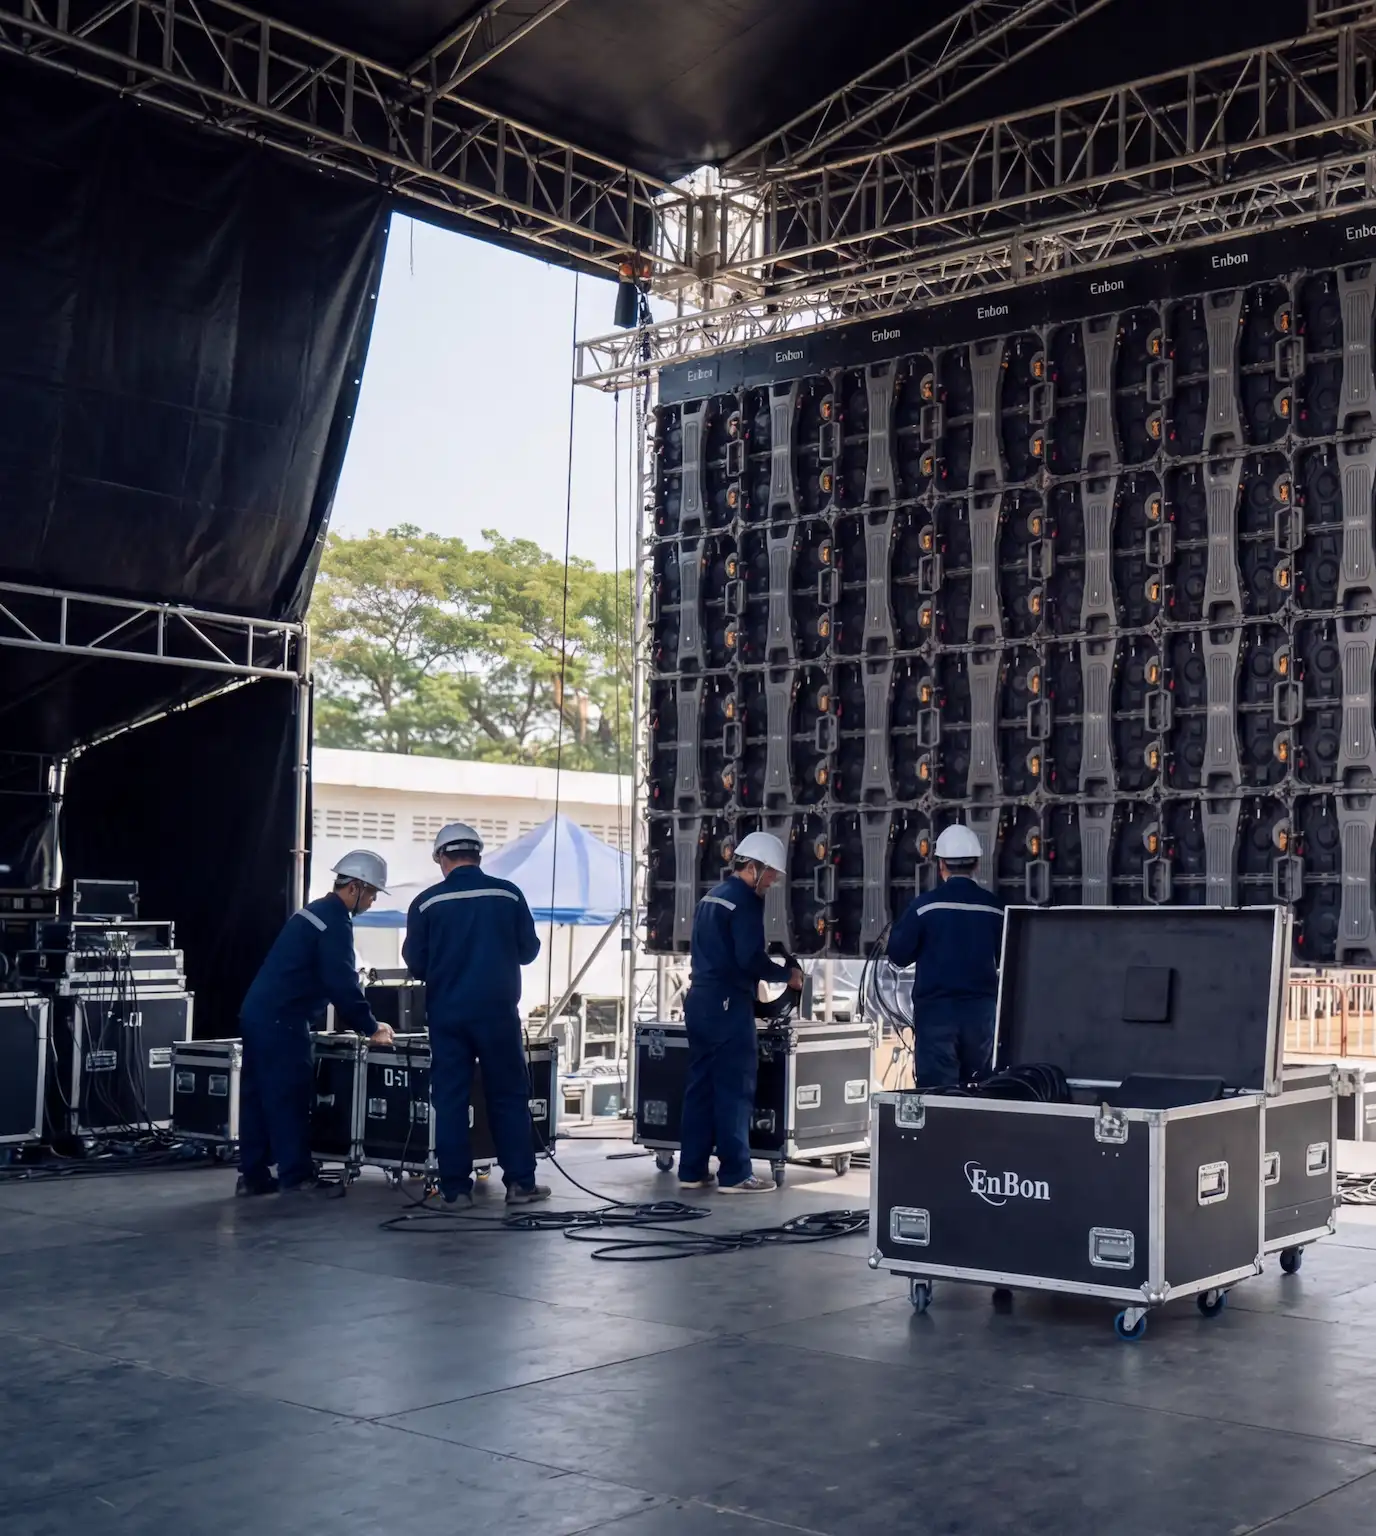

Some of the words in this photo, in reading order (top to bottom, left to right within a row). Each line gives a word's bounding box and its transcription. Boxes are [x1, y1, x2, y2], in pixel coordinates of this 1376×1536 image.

[1211, 253, 1249, 268] Enbon
[1090, 280, 1124, 295] Enbon
[970, 1168, 1051, 1201] EnBon
